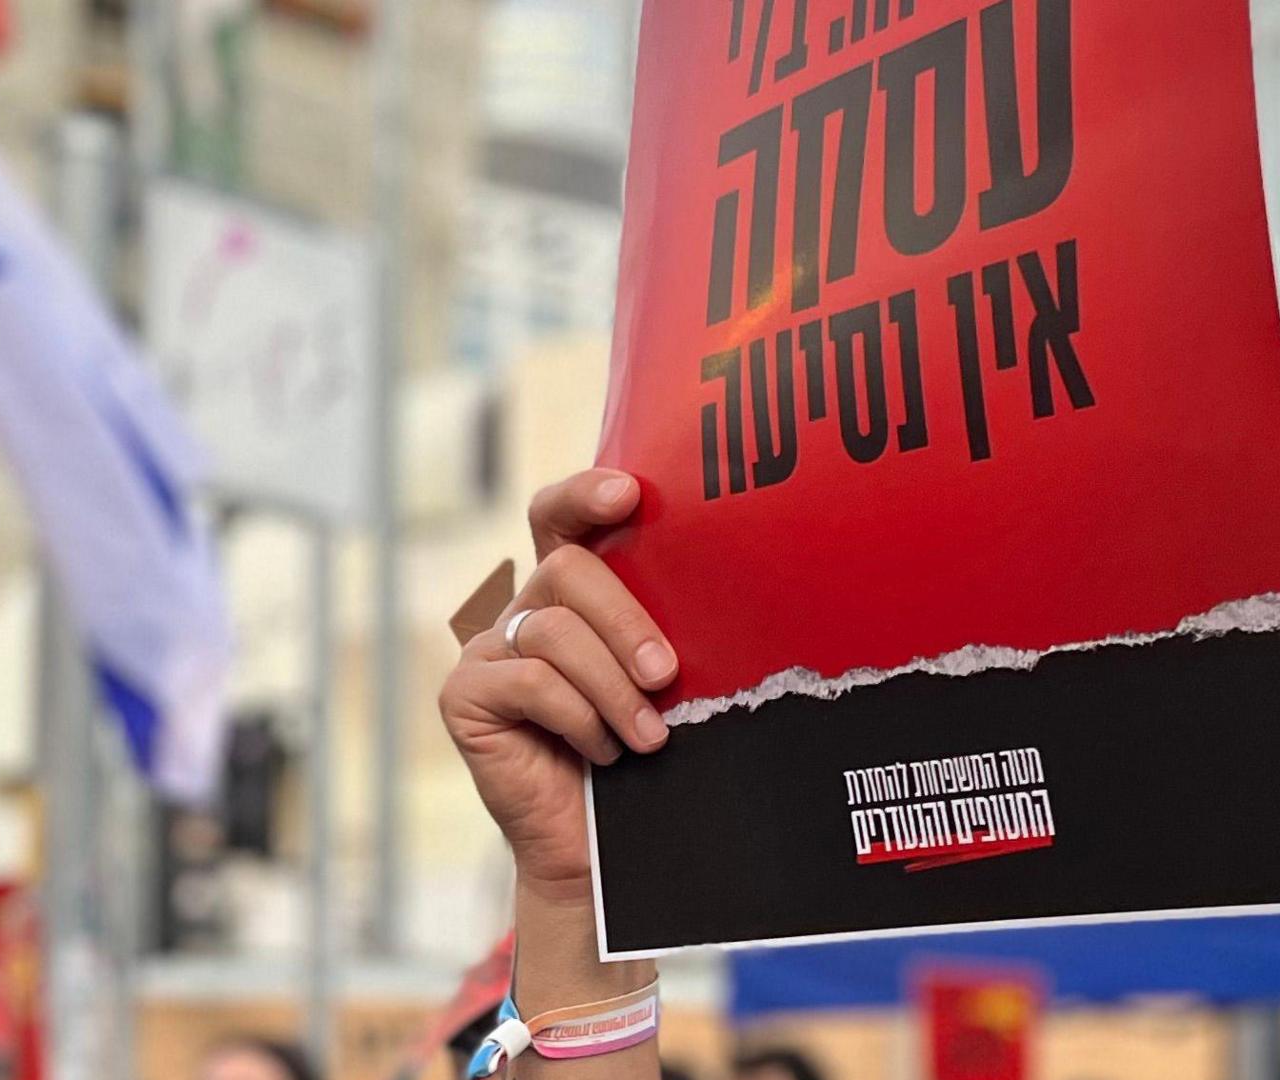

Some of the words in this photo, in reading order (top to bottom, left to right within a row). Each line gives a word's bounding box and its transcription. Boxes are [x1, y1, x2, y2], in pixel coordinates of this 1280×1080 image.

[705, 0, 1076, 327] עסקה
[946, 238, 1097, 462] אין
[700, 288, 929, 502] נסיעה
[844, 763, 910, 805] להחזרת
[910, 753, 1000, 797] המשפחות
[1000, 748, 1045, 784] מטה
[851, 802, 952, 855] והנעדרים
[951, 790, 1056, 843] החטופים
